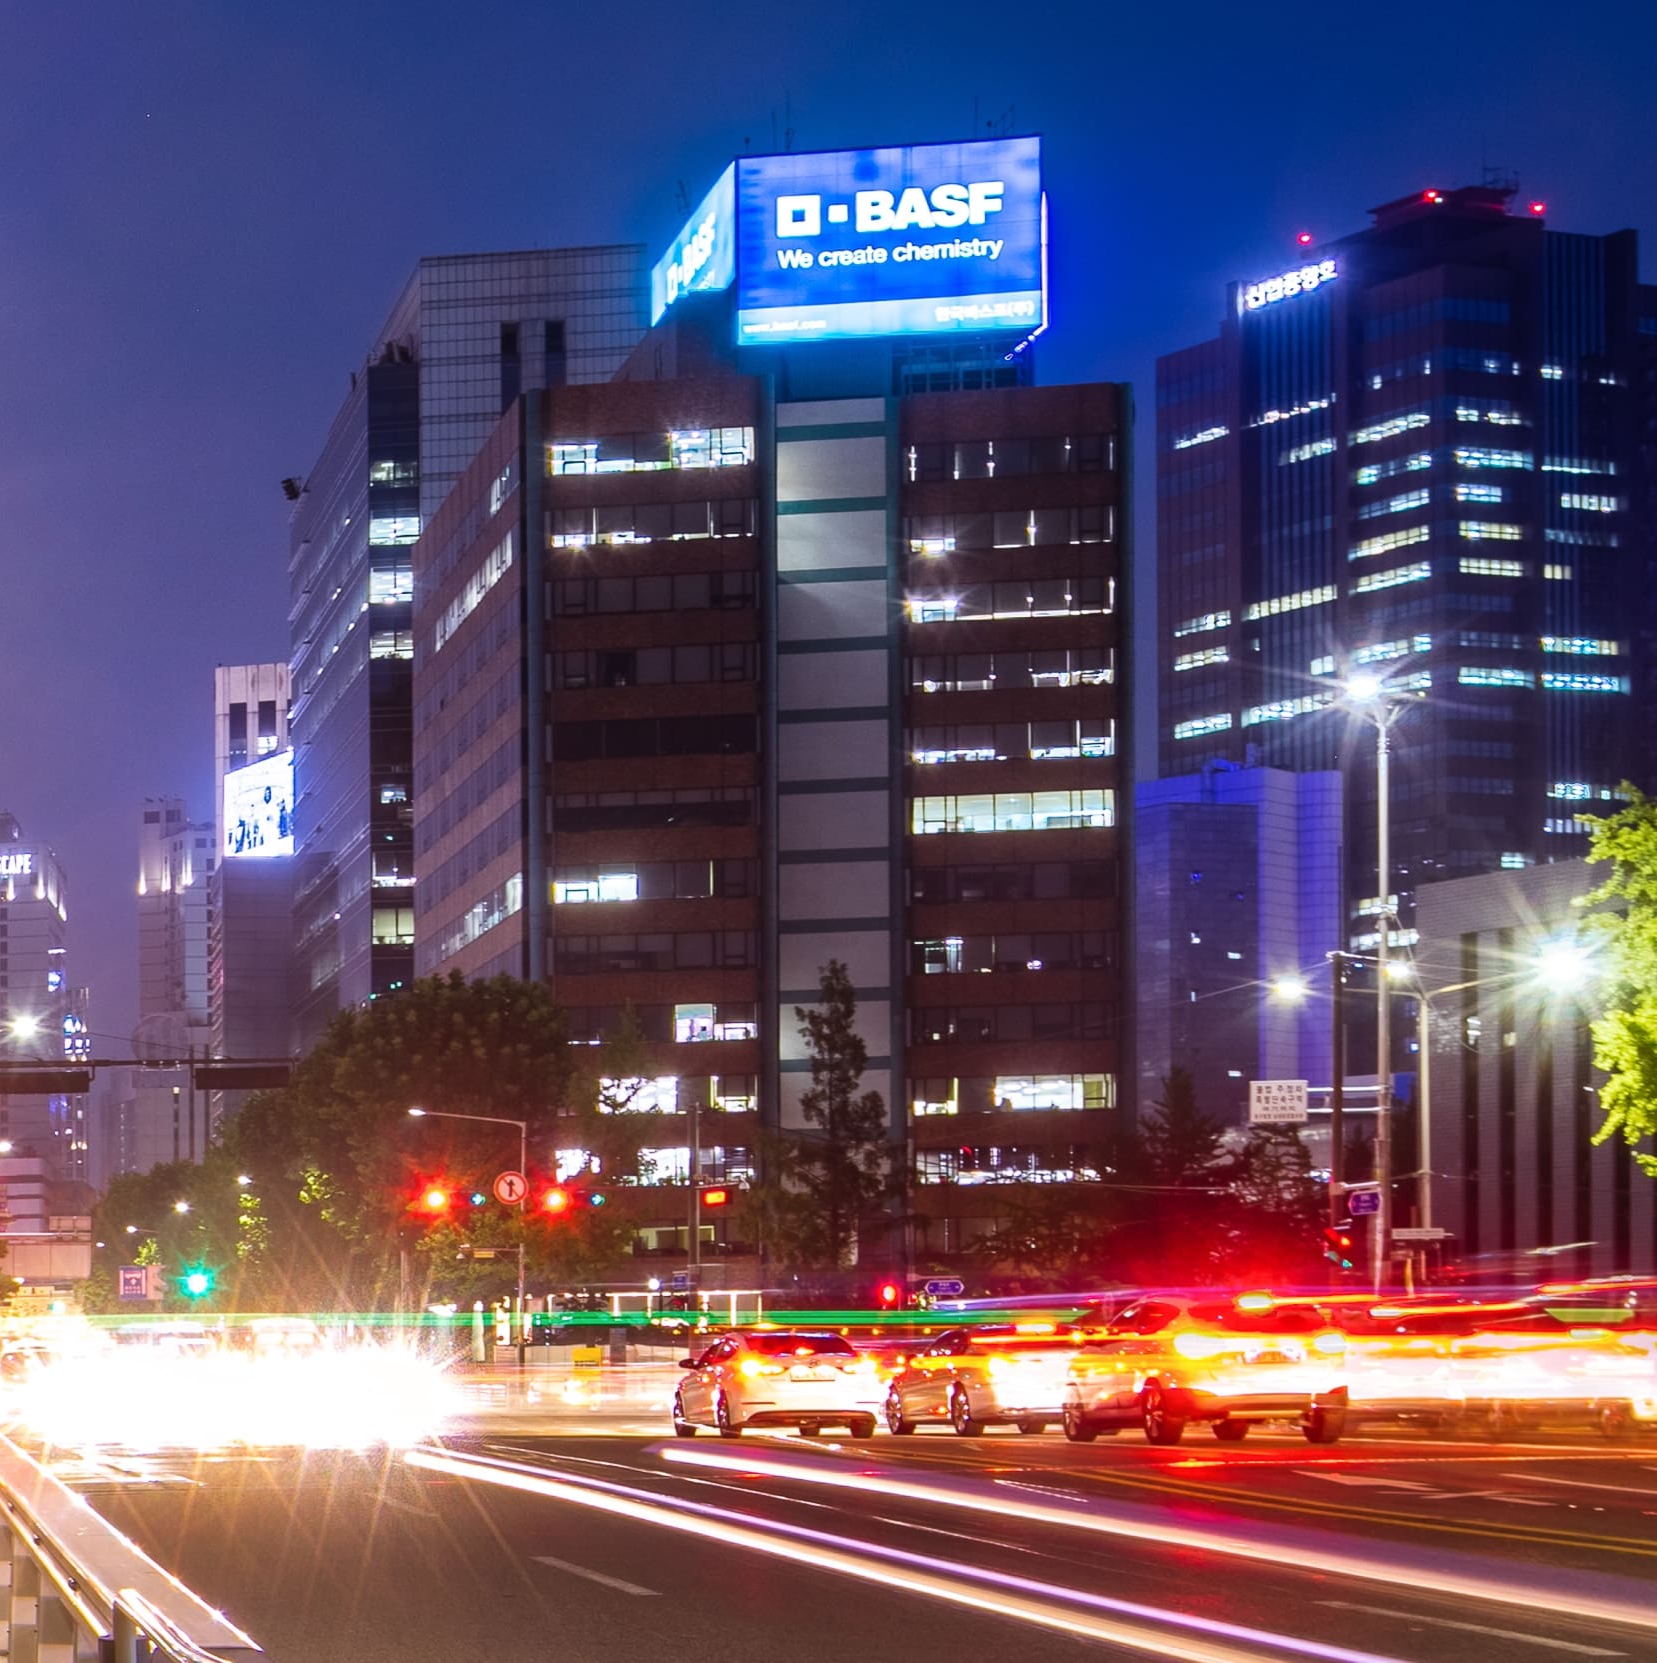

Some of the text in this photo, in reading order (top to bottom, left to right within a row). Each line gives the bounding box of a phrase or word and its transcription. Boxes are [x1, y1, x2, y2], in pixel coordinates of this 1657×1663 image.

[855, 180, 1004, 233] BASF
[682, 212, 716, 288] BASF
[776, 237, 1004, 270] We create chemistry
